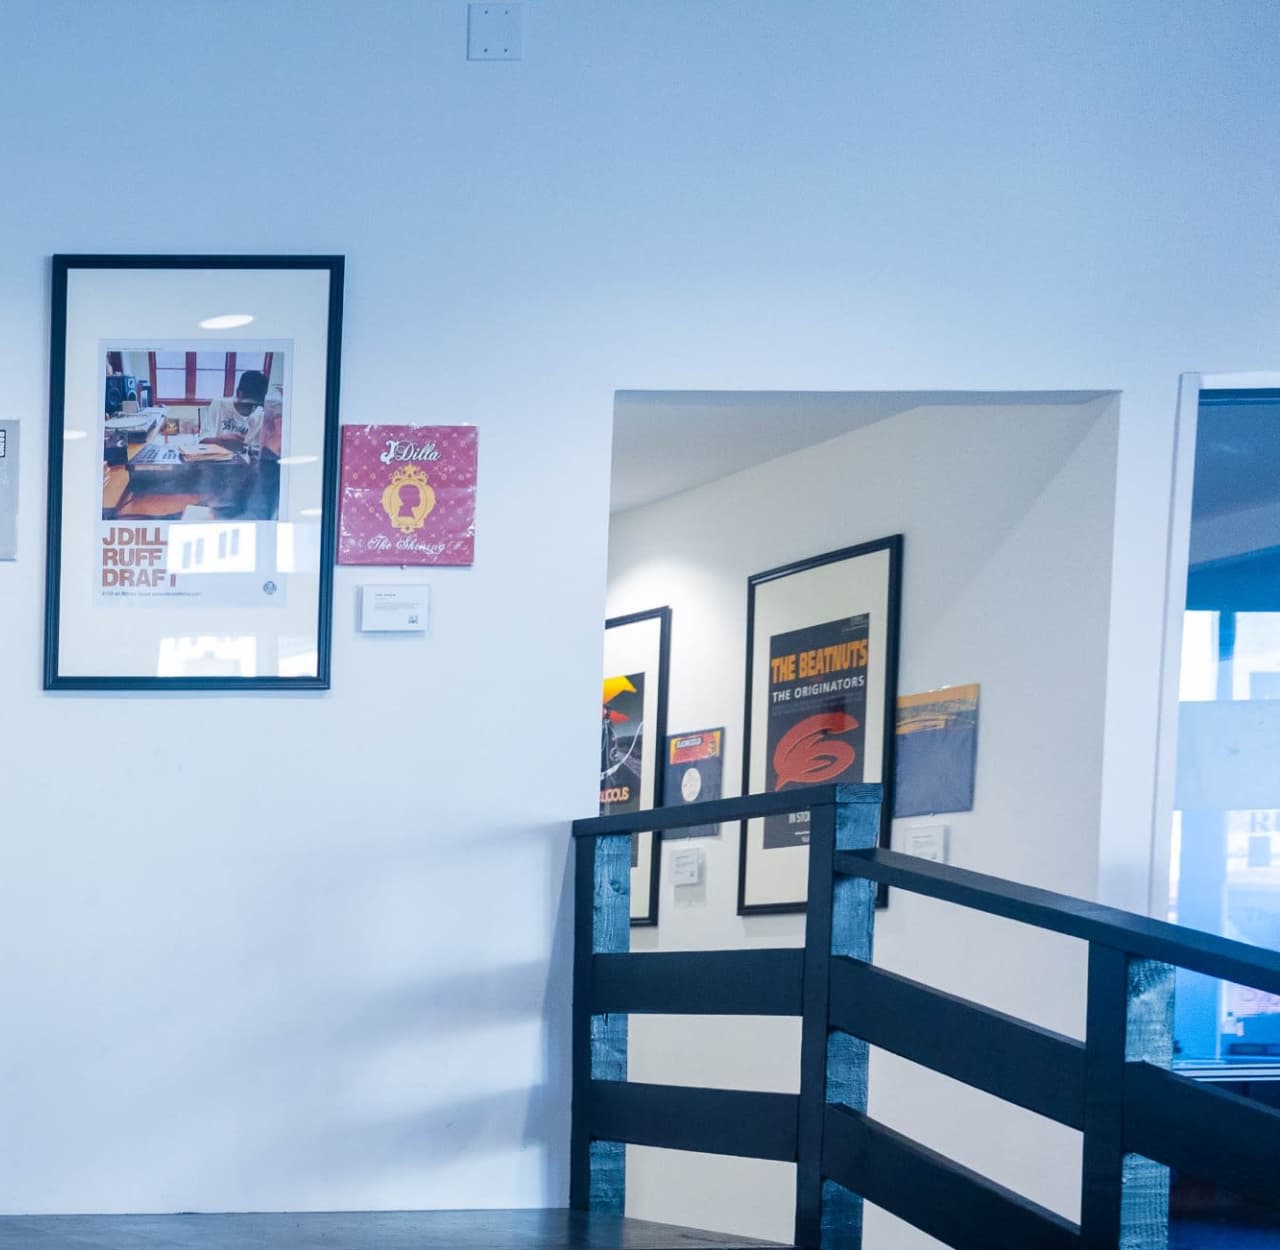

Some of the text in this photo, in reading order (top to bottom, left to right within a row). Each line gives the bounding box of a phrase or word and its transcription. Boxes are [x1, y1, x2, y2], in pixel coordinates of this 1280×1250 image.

[102, 527, 168, 545] JDILL
[102, 548, 162, 566] RUFF
[771, 638, 869, 684] THE BEATNUTS
[772, 675, 865, 704] THE ORIGINATORS
